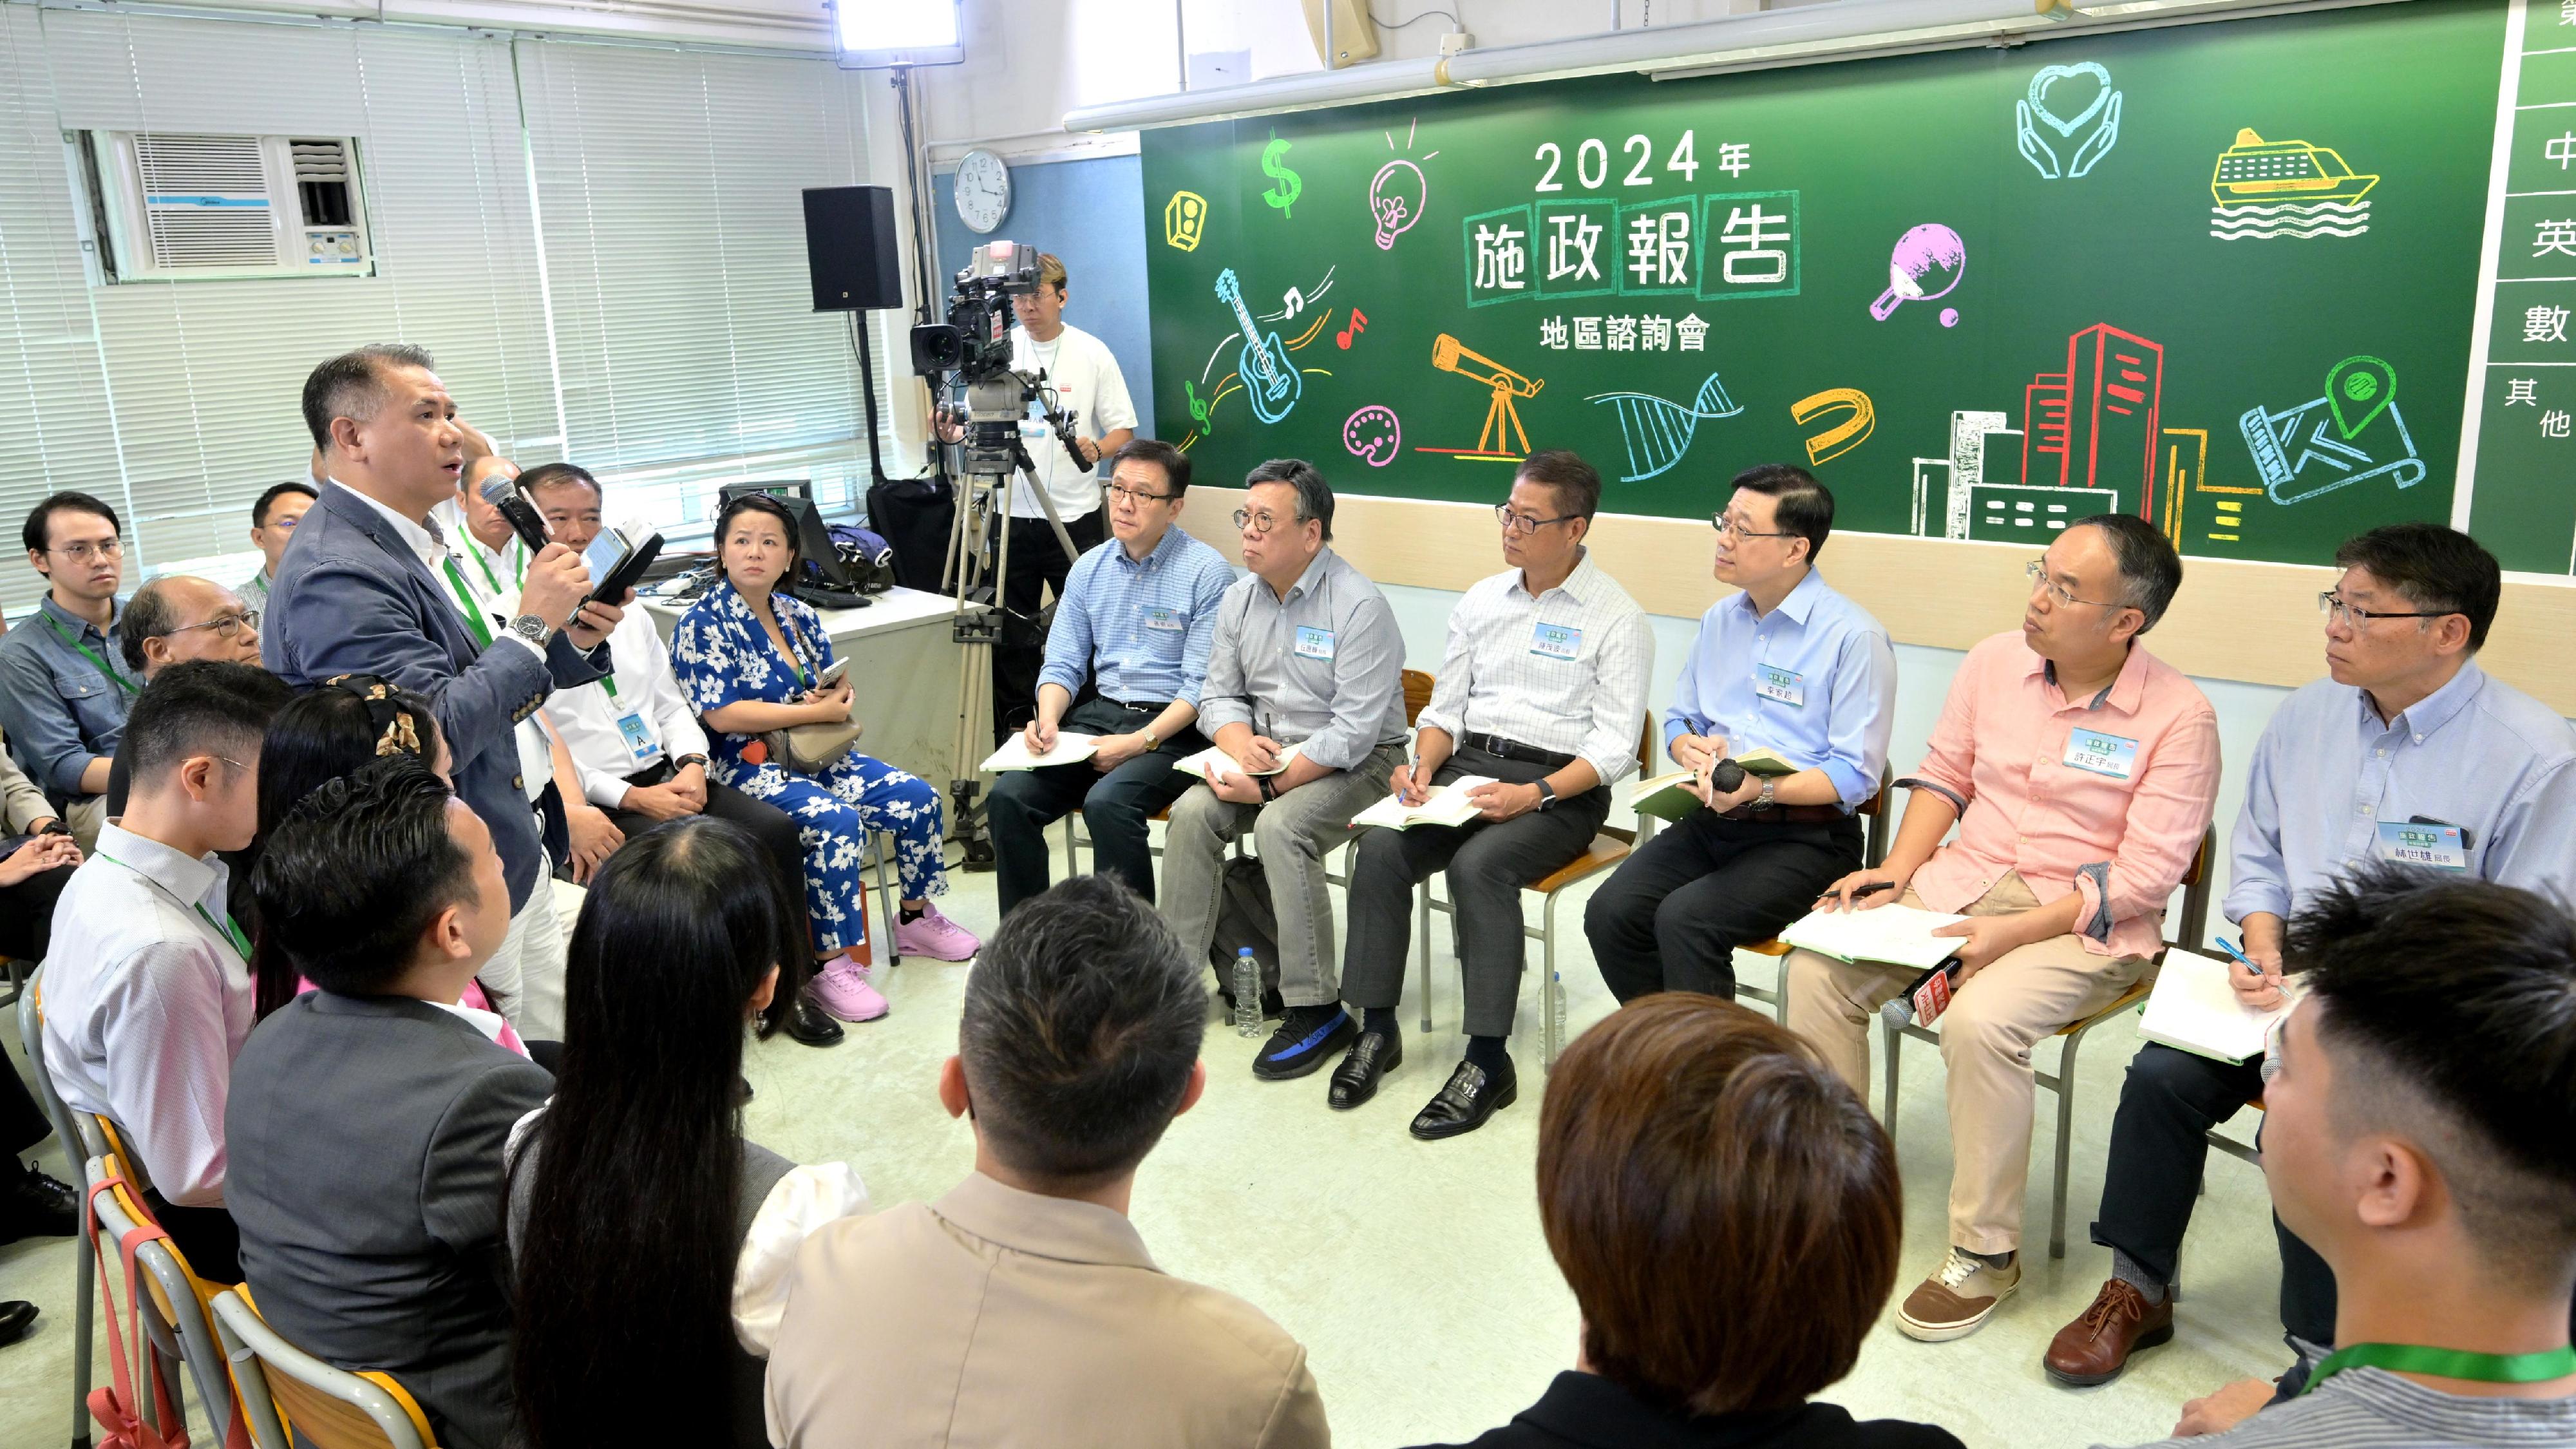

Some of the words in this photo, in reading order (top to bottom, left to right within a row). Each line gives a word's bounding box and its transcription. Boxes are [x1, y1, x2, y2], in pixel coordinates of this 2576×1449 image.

[980, 158, 987, 167] 12
[1535, 130, 1750, 192] 2024年
[966, 173, 974, 182] 10
[996, 171, 1001, 180] 2
[965, 186, 971, 196] 9
[968, 200, 974, 210] 8
[974, 210, 980, 220] 7
[983, 213, 989, 223] 6
[991, 210, 997, 219] 5
[2532, 218, 2576, 258] 英
[1474, 204, 1791, 290] 施政報告
[2523, 305, 2571, 342] 數
[1540, 312, 1710, 352] 地區諮詢會
[1767, 686, 1792, 700] 李家超
[636, 735, 646, 746] A
[2074, 752, 2107, 766] 許正宇
[2395, 848, 2433, 862] 林世雄
[2434, 854, 2452, 864] 局長
[1920, 992, 1933, 1021] RTHK
